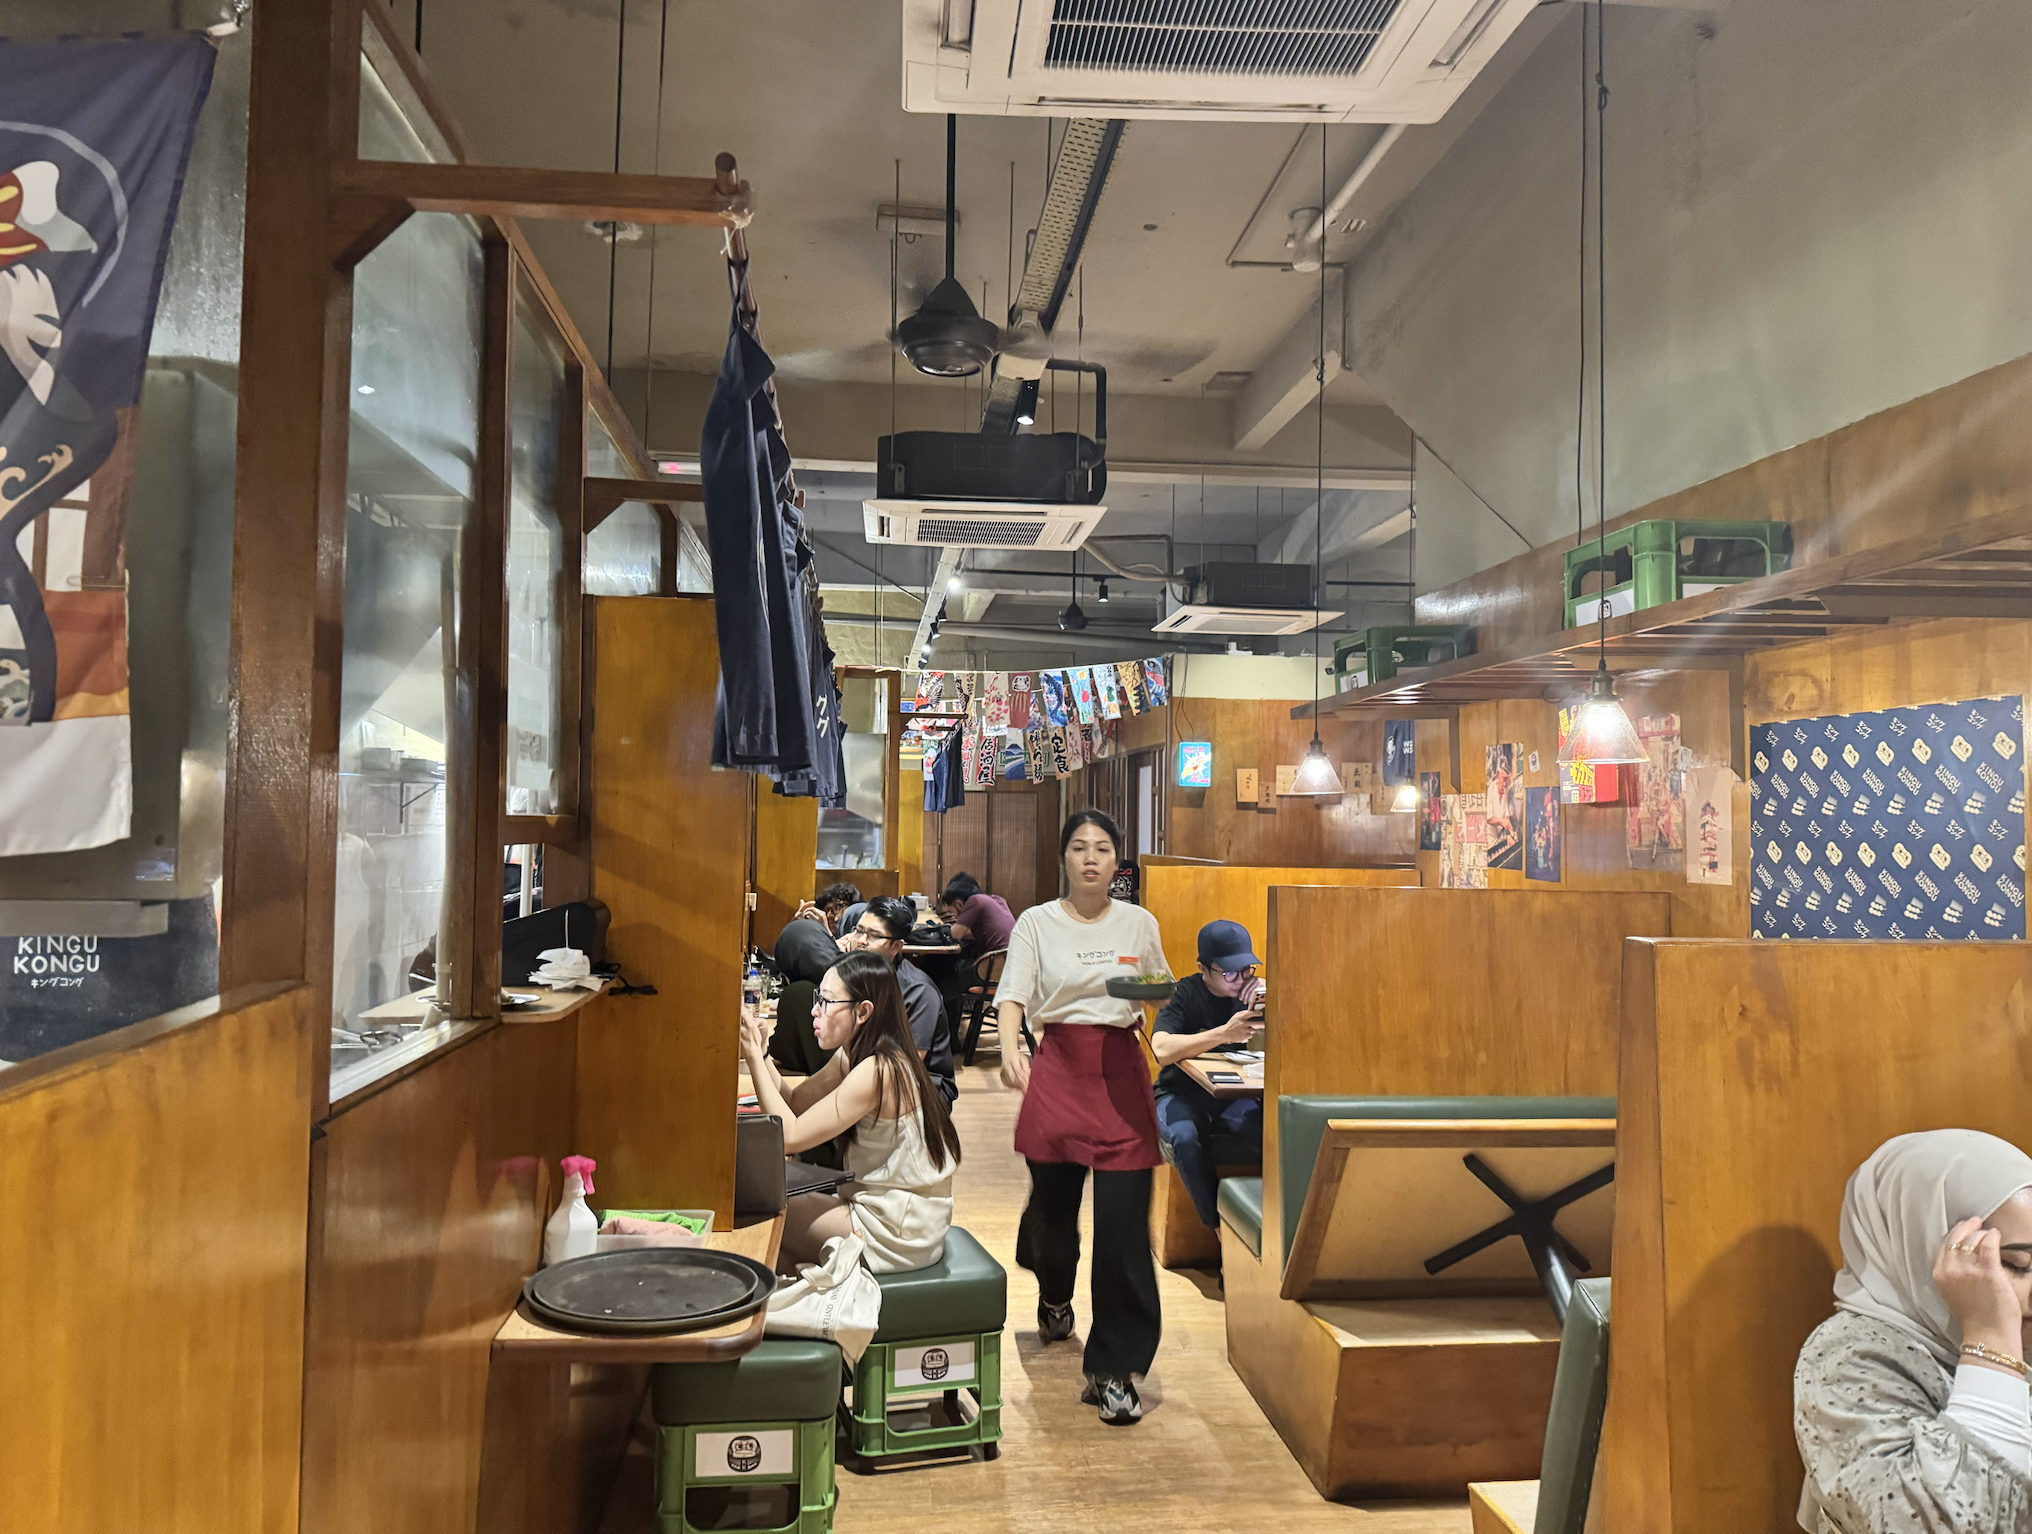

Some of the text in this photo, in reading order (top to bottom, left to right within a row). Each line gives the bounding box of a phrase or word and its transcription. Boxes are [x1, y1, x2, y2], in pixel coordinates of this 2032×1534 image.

[1051, 733, 1069, 773] 定食
[18, 935, 98, 955] KINGU
[1076, 949, 1116, 959] キングコング
[13, 954, 100, 974] KONGU
[31, 977, 84, 989] キングコング
